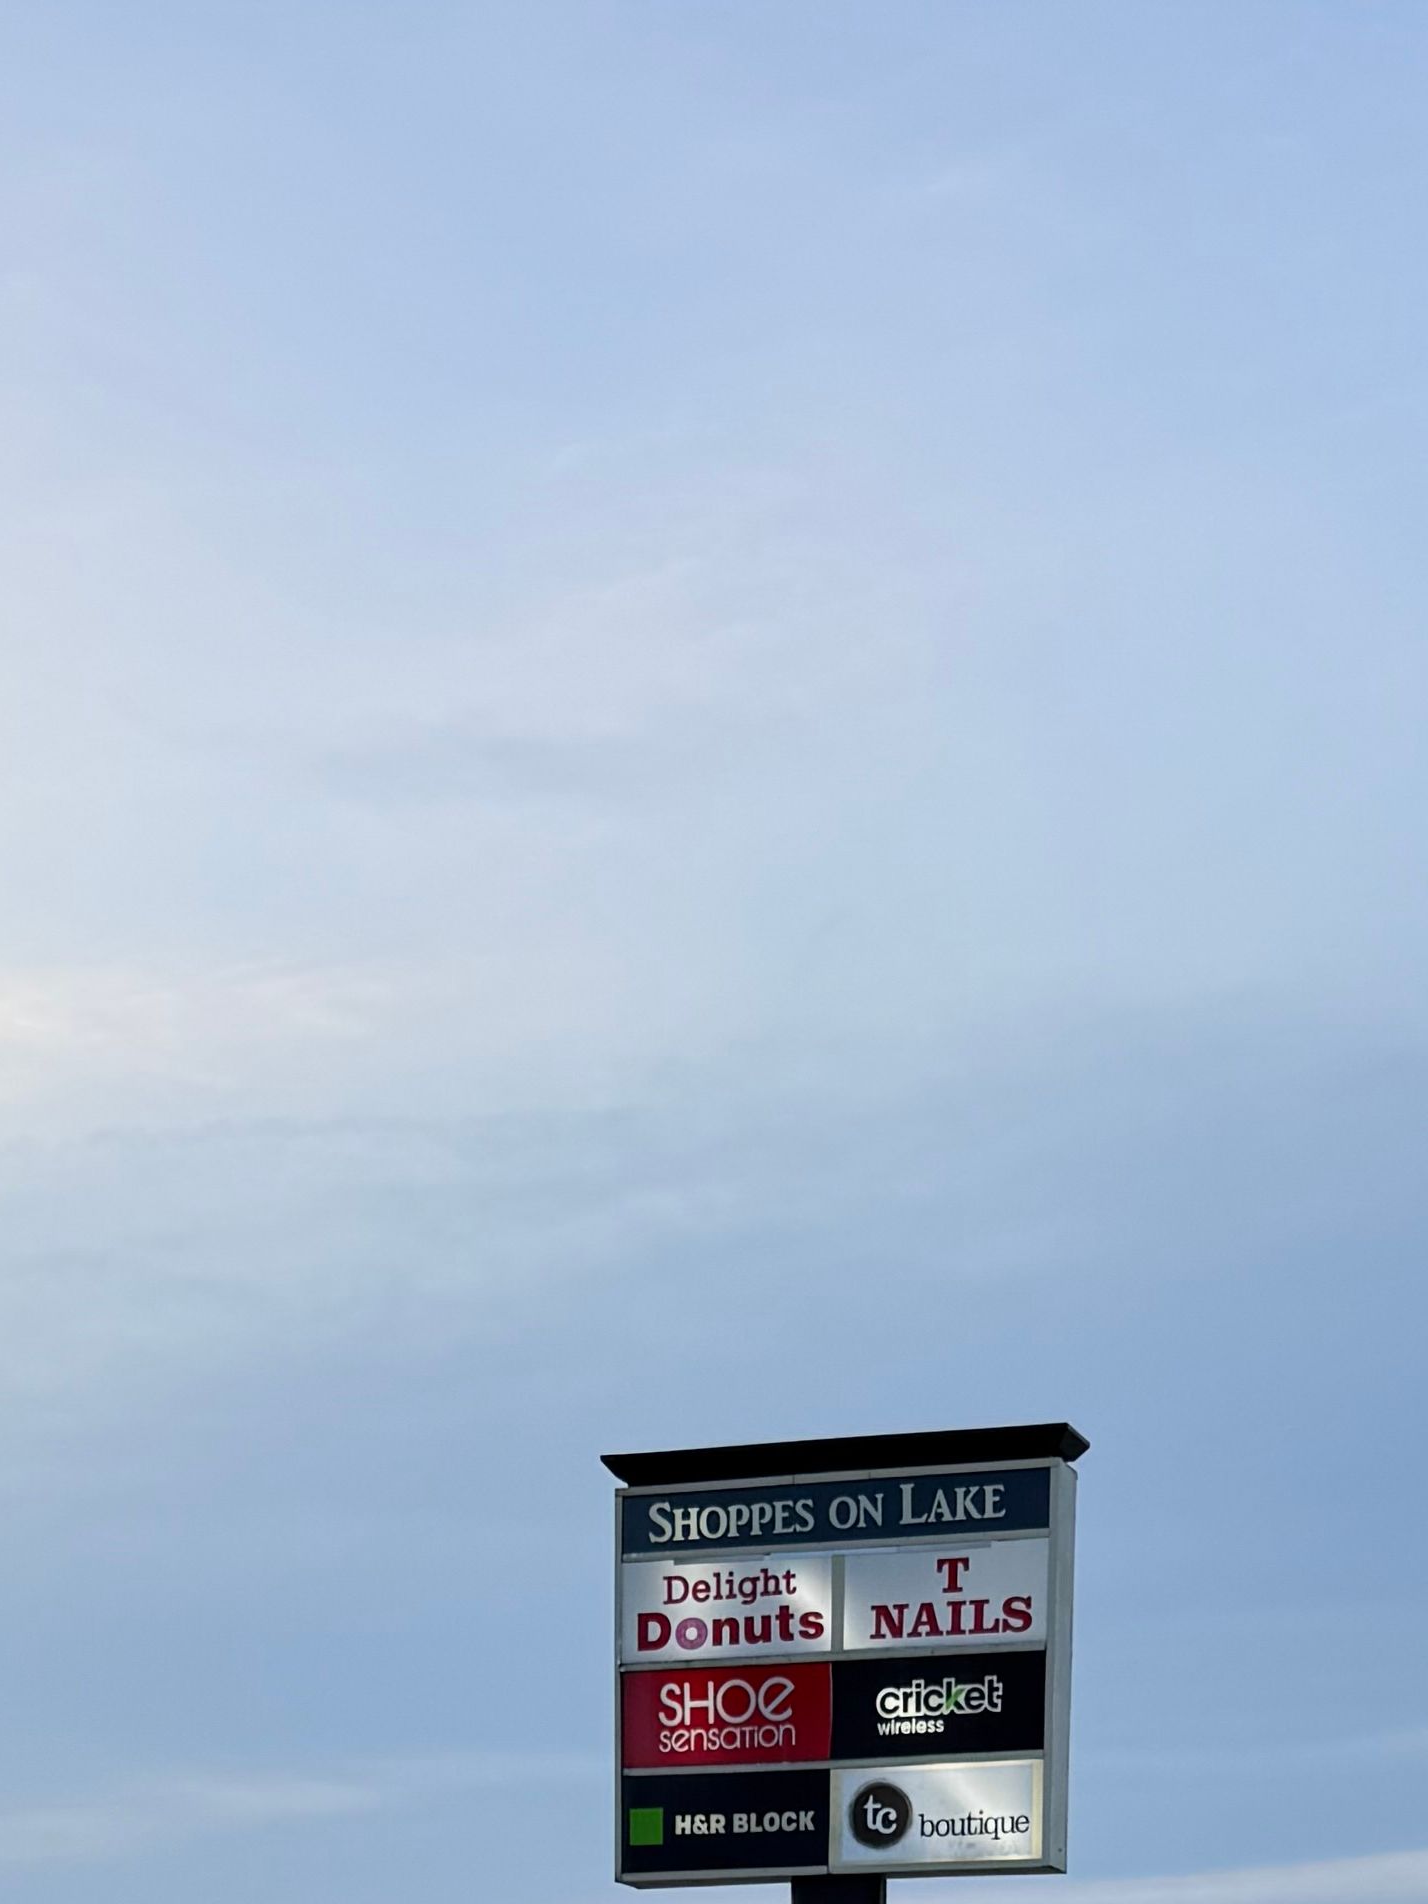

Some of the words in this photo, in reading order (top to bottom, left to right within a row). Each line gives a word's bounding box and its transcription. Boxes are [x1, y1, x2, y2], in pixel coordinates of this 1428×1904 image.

[648, 1499, 815, 1543] SHOPPES
[829, 1493, 884, 1529] ON
[899, 1483, 1006, 1525] LAKE
[662, 1568, 797, 1605] Delight
[936, 1557, 970, 1593] T
[637, 1605, 825, 1652] Donuts
[869, 1596, 1033, 1639] NAILS
[875, 1675, 1003, 1719] cricket
[658, 1724, 796, 1753] sensation
[876, 1718, 945, 1736] wireless
[674, 1813, 726, 1836] H&R
[732, 1810, 815, 1833] BLOCK
[863, 1794, 898, 1835] tc
[917, 1809, 1030, 1841] boutique
